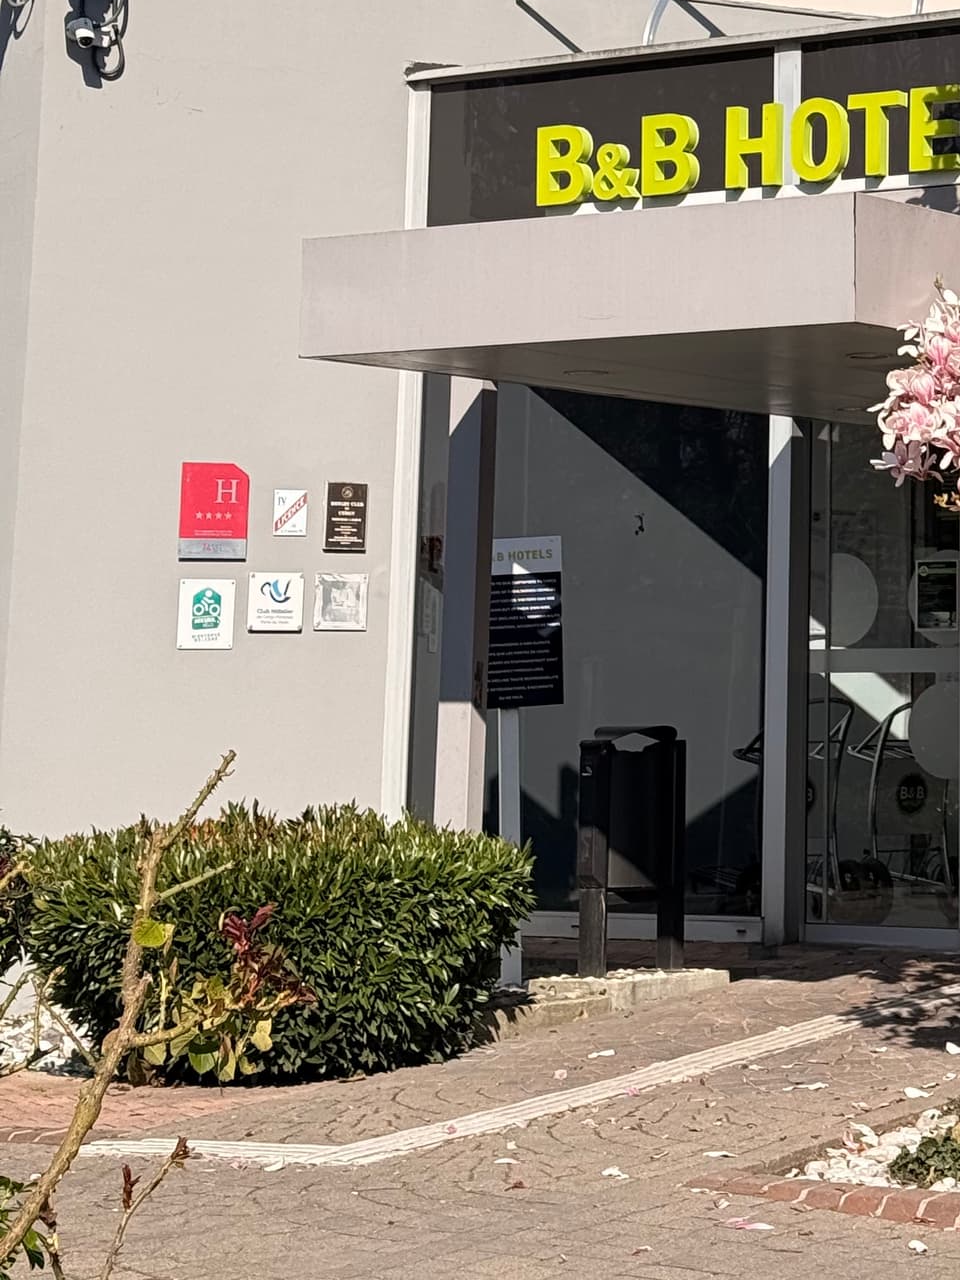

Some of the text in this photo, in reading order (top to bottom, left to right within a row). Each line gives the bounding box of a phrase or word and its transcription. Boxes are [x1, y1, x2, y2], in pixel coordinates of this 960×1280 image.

[536, 113, 699, 207] B&B
[215, 479, 240, 504] H
[508, 548, 553, 561] HOTELS
